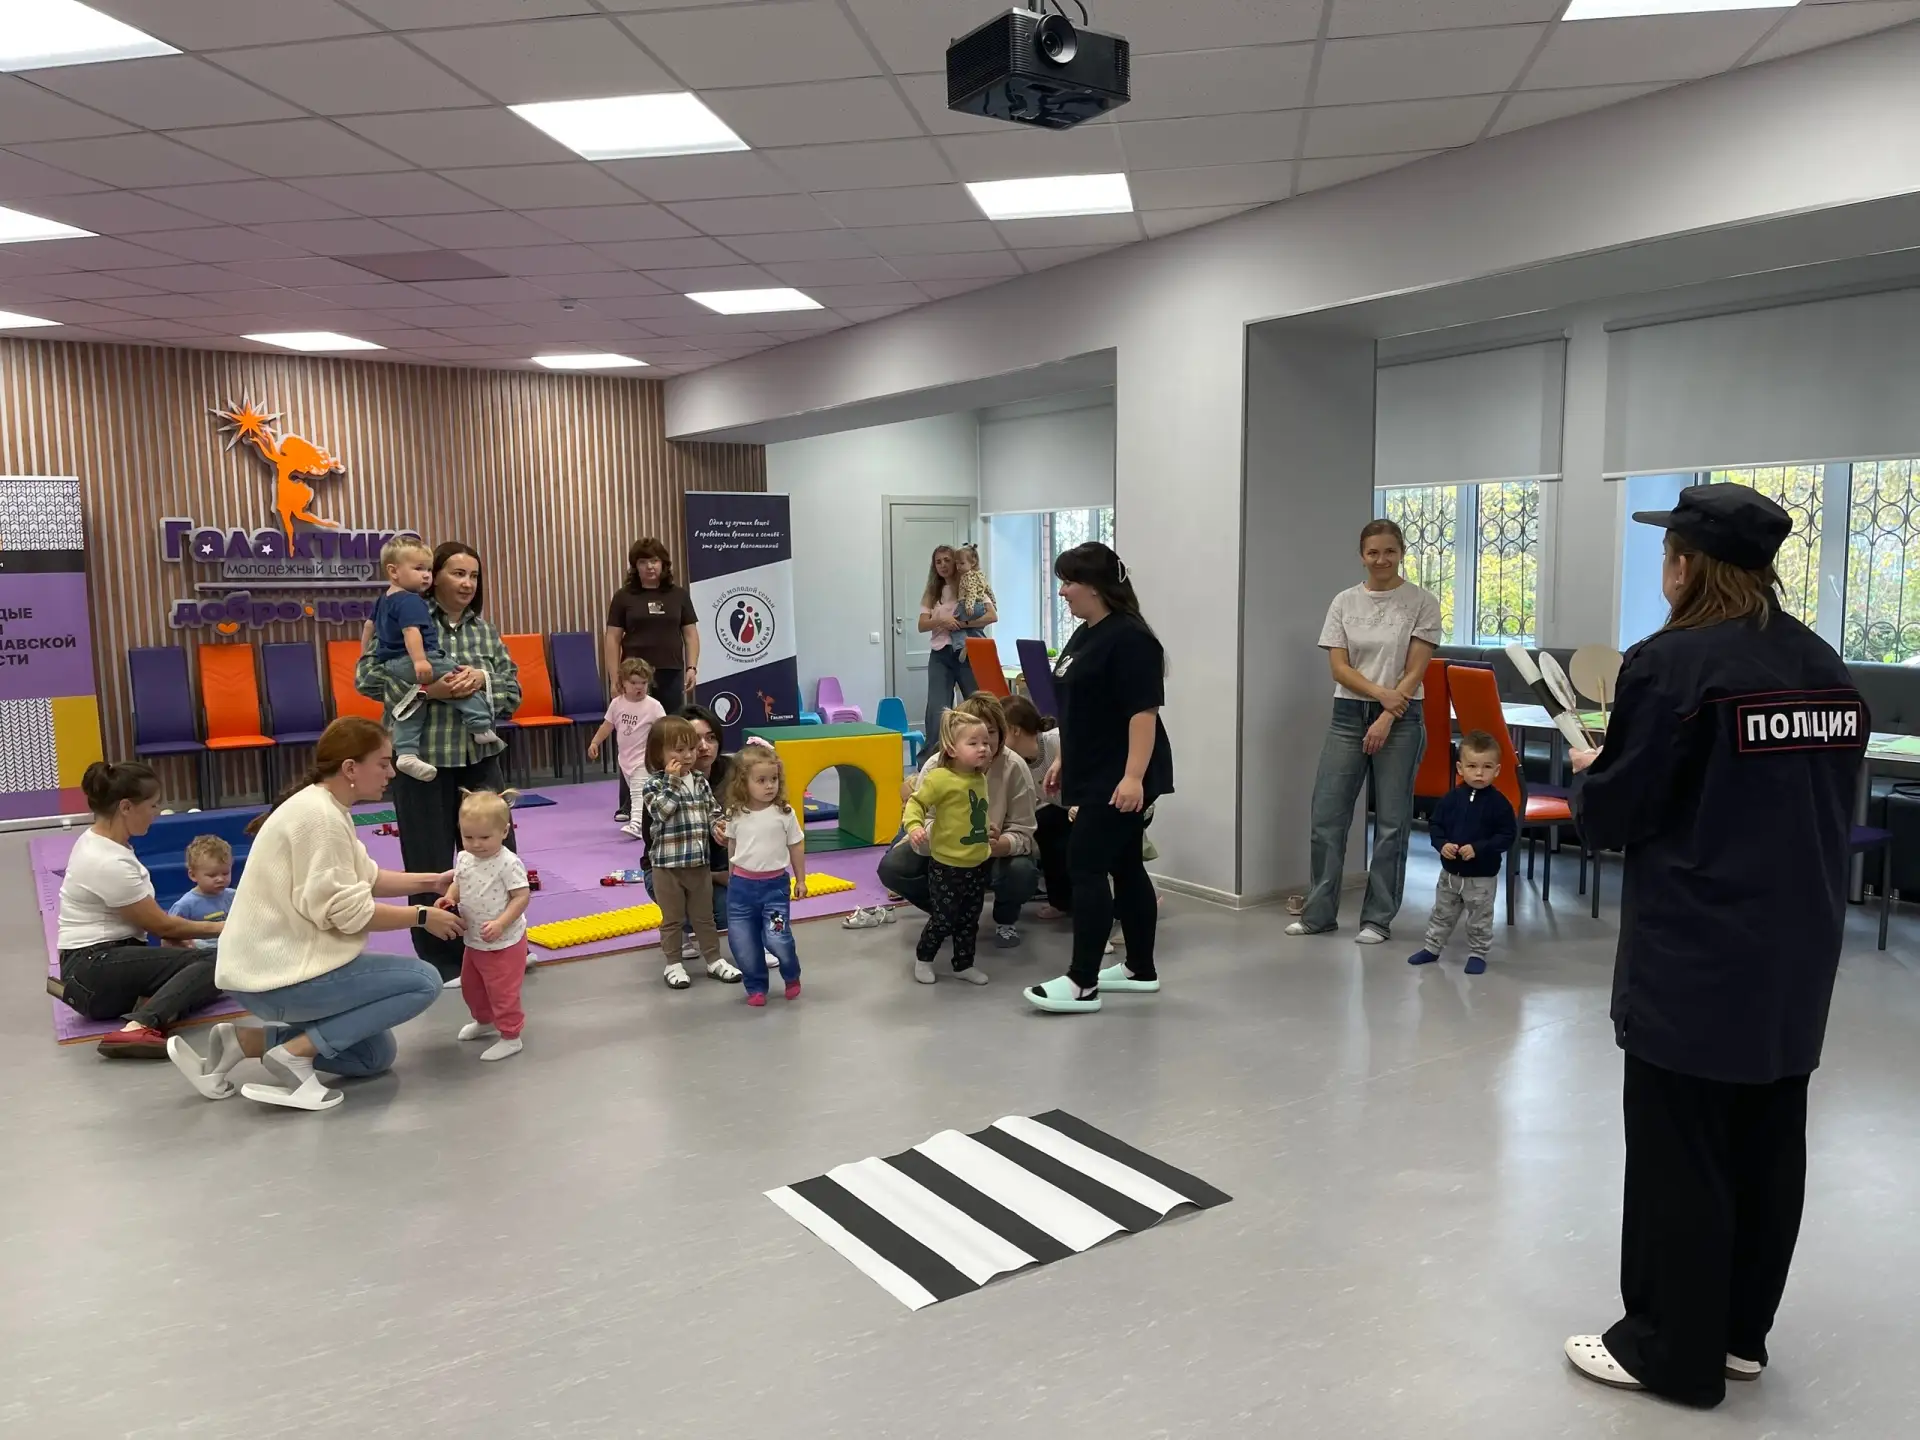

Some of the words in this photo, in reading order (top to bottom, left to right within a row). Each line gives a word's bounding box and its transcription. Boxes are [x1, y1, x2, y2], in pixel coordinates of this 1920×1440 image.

[163, 519, 422, 560] Галактик
[226, 561, 324, 576] молодежный
[329, 564, 371, 579] центр
[711, 591, 727, 609] Клуб
[727, 586, 758, 596] молодой
[758, 591, 776, 609] семьи
[719, 628, 752, 653] АКАДЕМИЯ
[755, 626, 771, 649] СЕМЬИ
[1747, 711, 1857, 742] ПОЛЦИЯ
